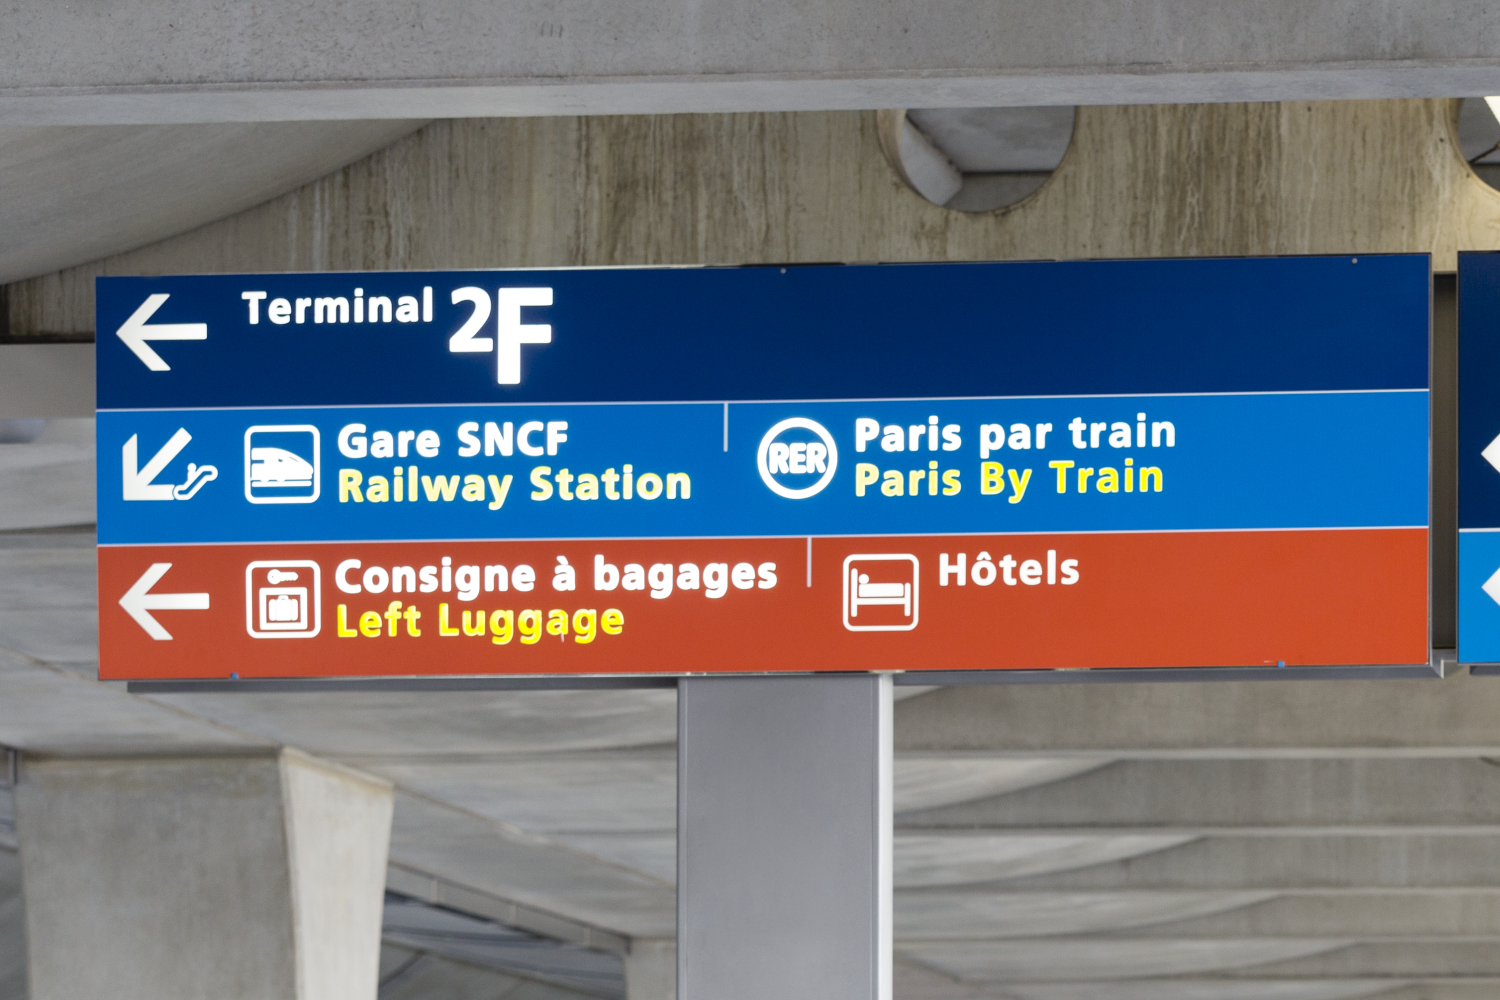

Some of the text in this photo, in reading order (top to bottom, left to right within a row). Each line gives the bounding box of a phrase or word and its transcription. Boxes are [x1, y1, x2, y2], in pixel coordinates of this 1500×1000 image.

[242, 287, 553, 384] Terminal 2F
[338, 421, 568, 458] Gare SNCF
[768, 442, 828, 475] RER
[856, 413, 1175, 459] Paris par train
[339, 463, 690, 510] Railway Station
[856, 458, 1162, 503] Paris By Train
[335, 554, 777, 600] Consigne à bagages
[940, 550, 1079, 586] Hôtels
[337, 601, 624, 645] Left Luggage
